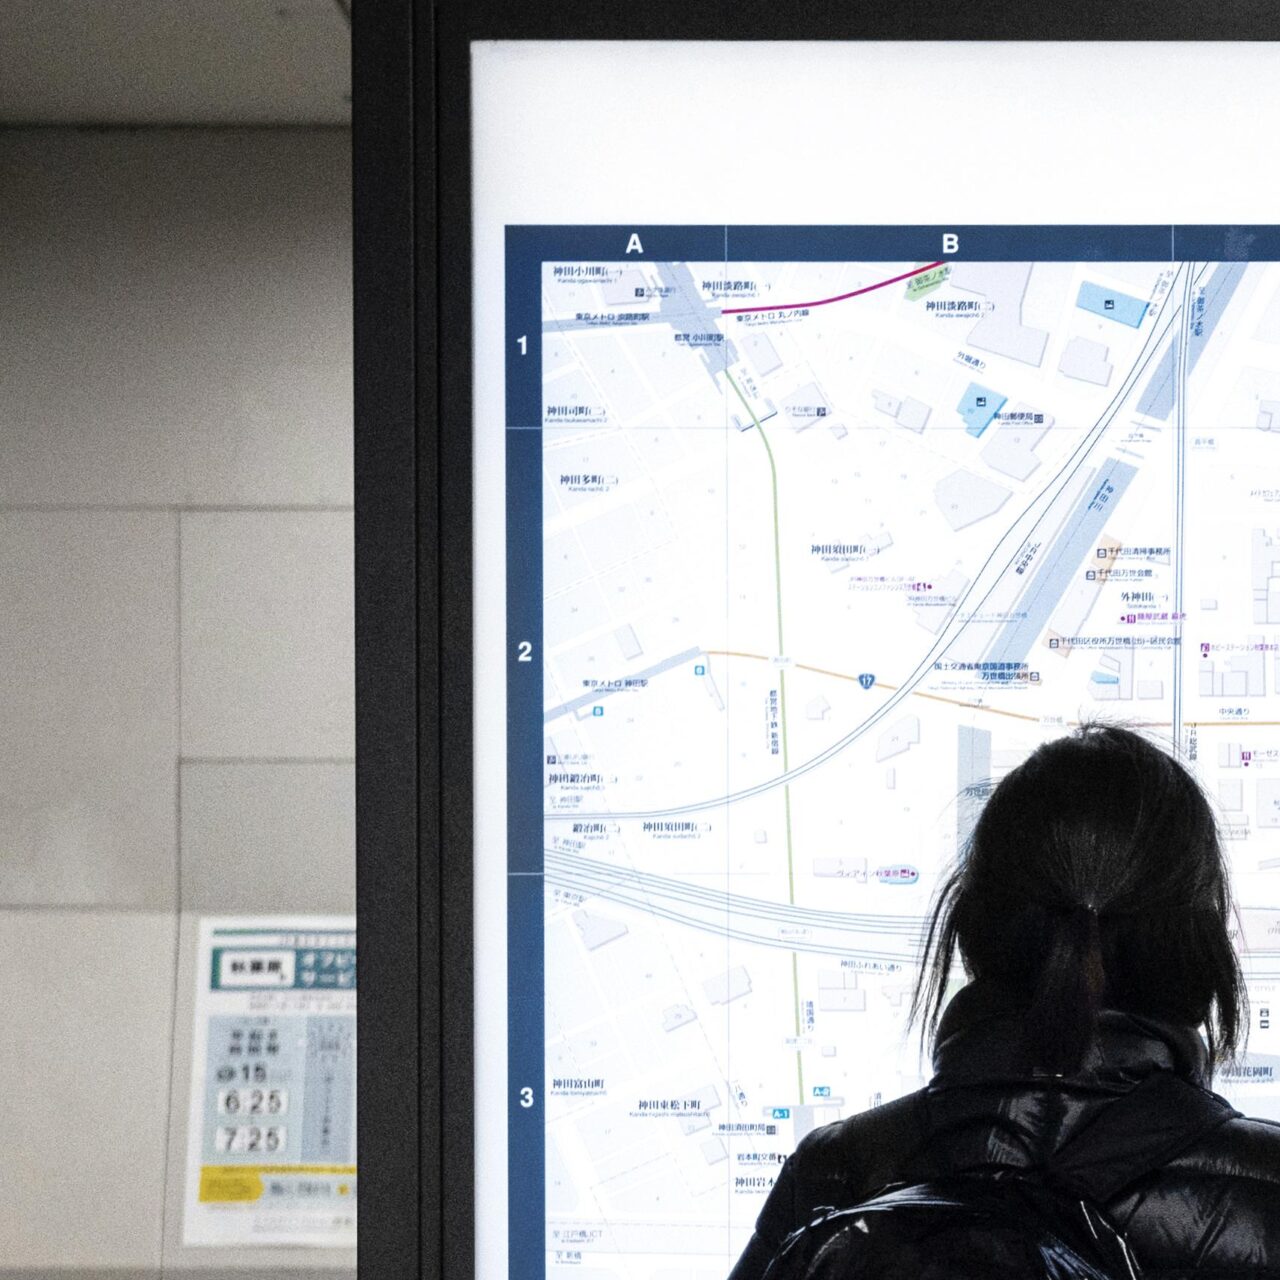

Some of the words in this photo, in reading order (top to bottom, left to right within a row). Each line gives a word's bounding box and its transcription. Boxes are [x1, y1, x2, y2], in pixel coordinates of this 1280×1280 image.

[626, 233, 643, 253] A
[943, 234, 958, 253] B
[517, 336, 527, 355] 1
[518, 642, 532, 661] 2
[520, 1087, 534, 1107] 3
